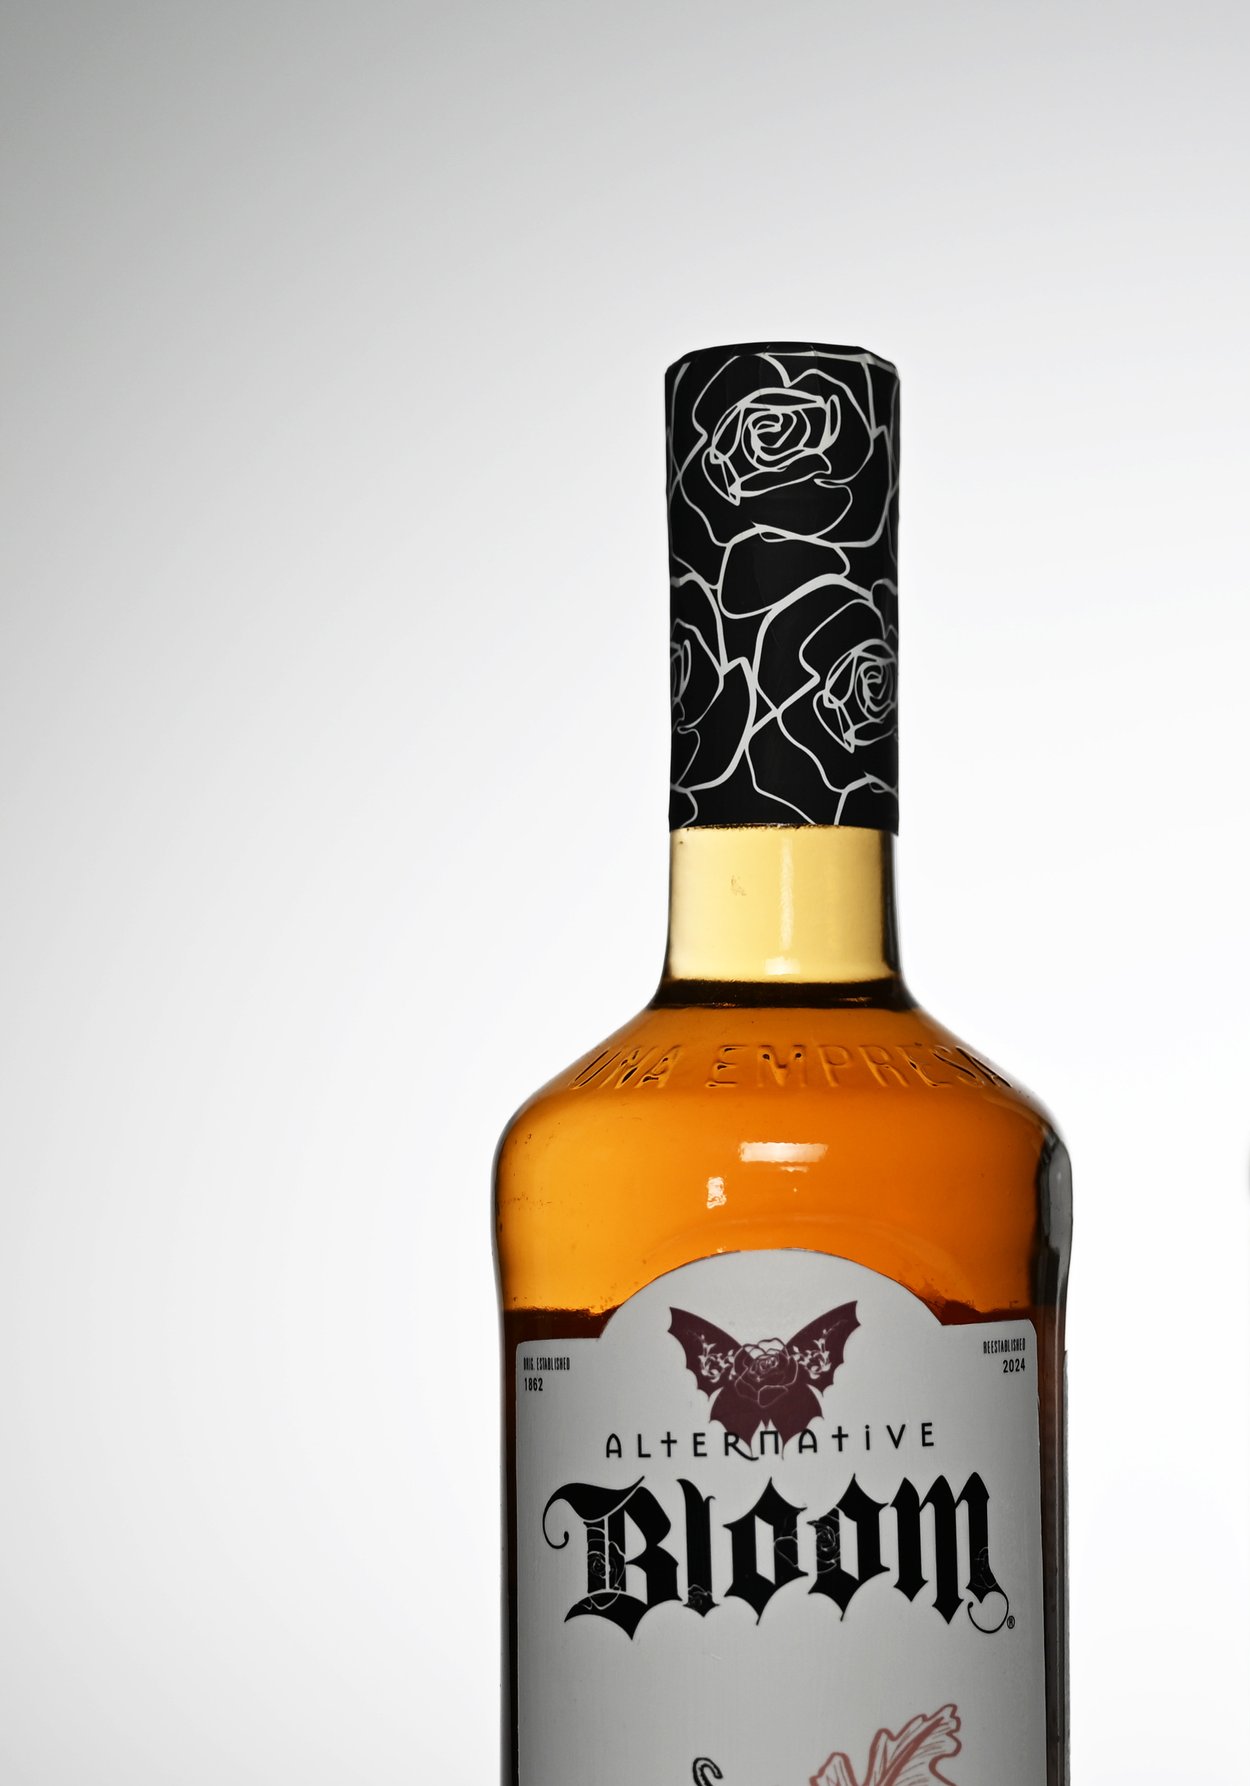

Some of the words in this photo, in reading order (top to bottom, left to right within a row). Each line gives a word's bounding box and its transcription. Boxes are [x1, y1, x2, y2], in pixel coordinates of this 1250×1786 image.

[568, 1043, 683, 1090] UNA
[704, 1042, 1015, 1090] EMPRESA
[983, 1337, 1026, 1354] REESTABLISHED
[536, 1356, 570, 1370] ESTABLISHED
[1003, 1357, 1026, 1373] 2024
[524, 1377, 543, 1391] 1862
[542, 1471, 1009, 1641] Bloom
